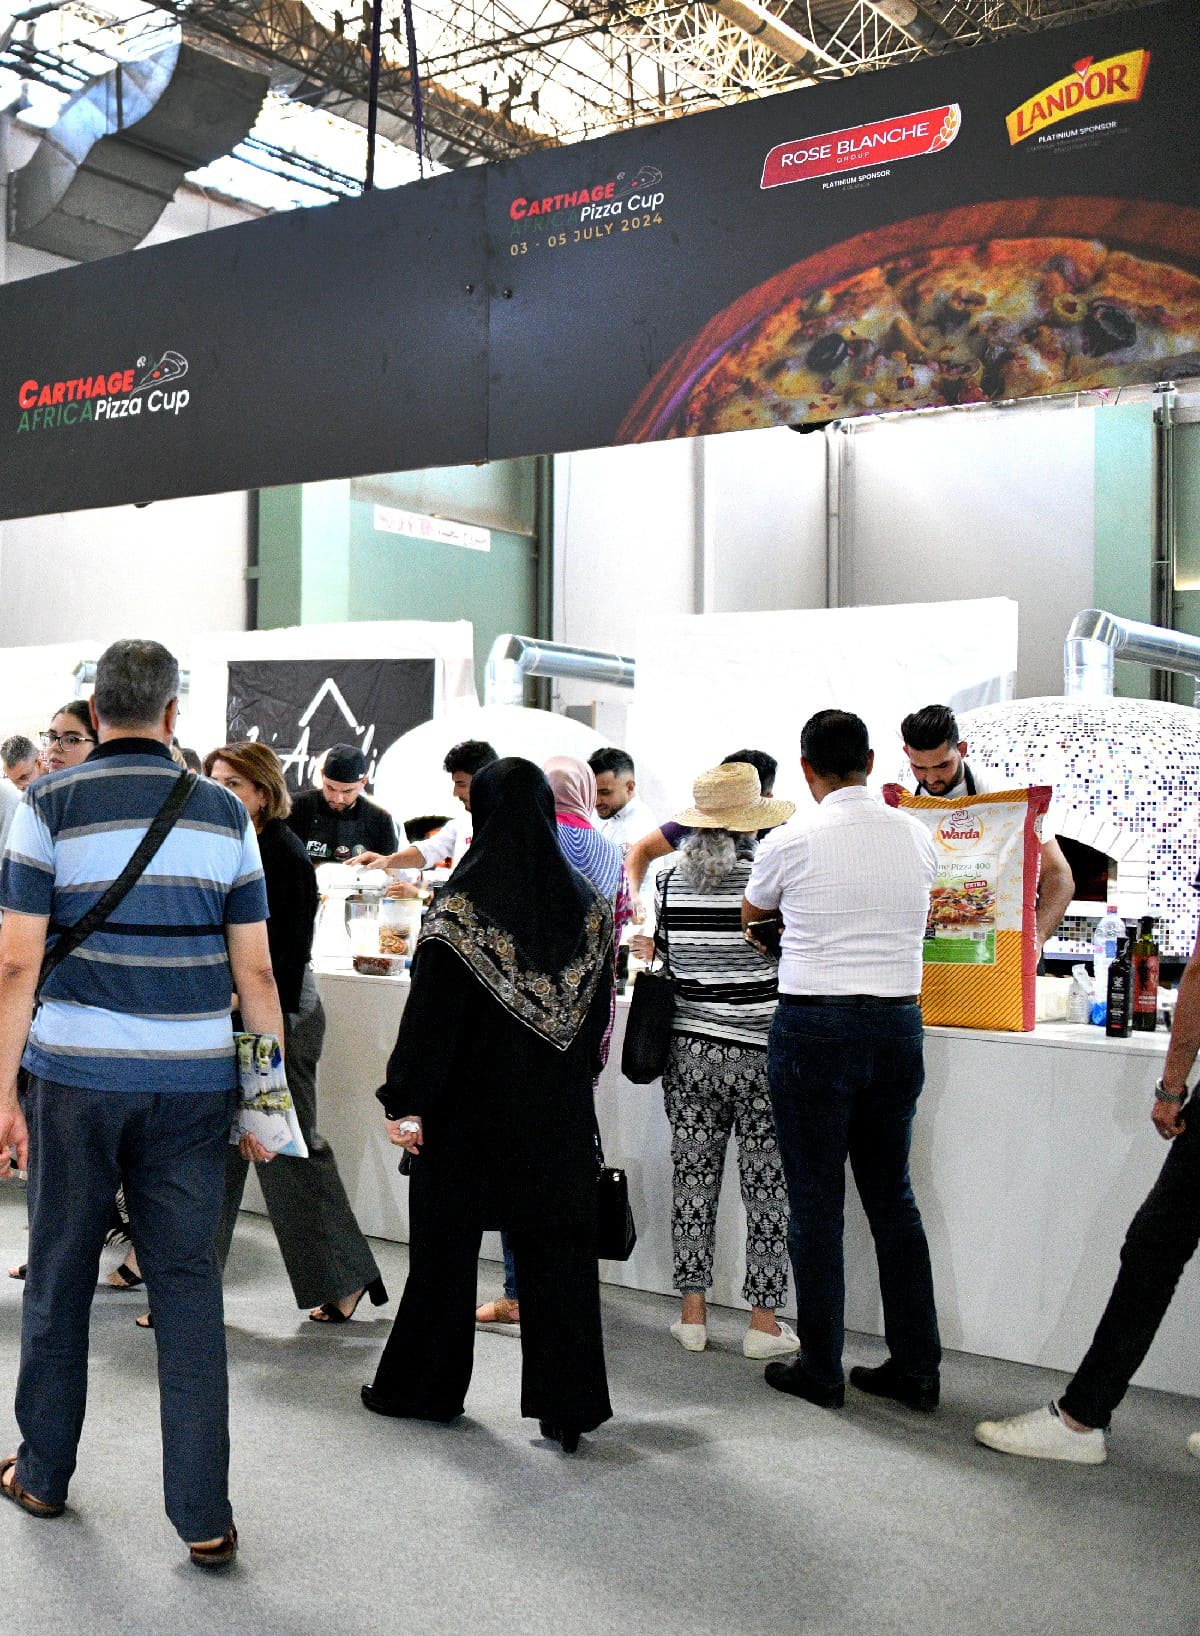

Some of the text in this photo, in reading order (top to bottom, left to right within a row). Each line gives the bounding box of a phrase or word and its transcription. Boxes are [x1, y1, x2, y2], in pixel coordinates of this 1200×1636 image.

[1016, 64, 1130, 137] LANDOR
[781, 122, 930, 167] ROSE BLANCHE
[1038, 121, 1118, 144] PLATINIUM SPONSOR
[822, 176, 857, 190] PLATINIUM
[858, 169, 891, 182] SPONSOR
[580, 201, 623, 223] Pizza
[627, 192, 665, 211] Cup
[510, 242, 528, 256] 03
[548, 233, 567, 248] 05
[573, 223, 614, 243] JULY
[621, 213, 663, 232] 2024
[17, 389, 190, 433] AFRICA Pizza Cup
[940, 827, 980, 840] Warda
[950, 862, 972, 870] Pizza
